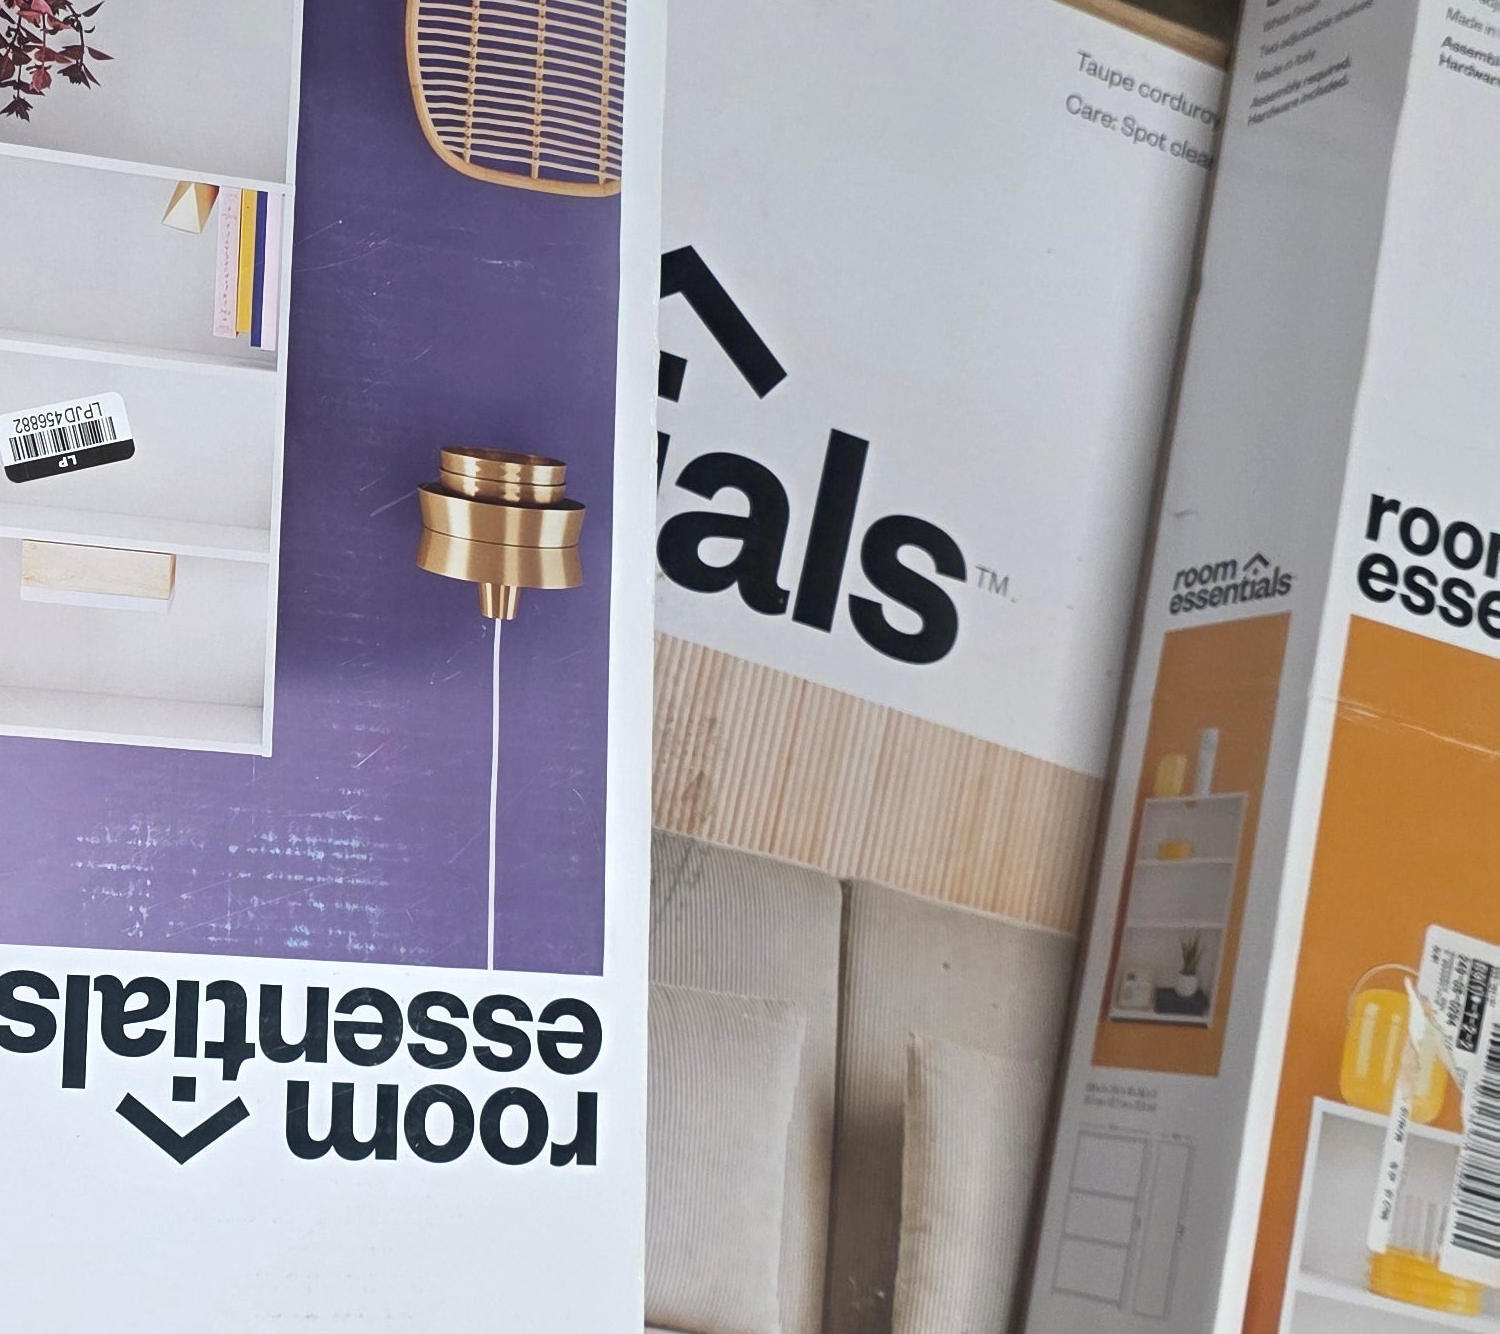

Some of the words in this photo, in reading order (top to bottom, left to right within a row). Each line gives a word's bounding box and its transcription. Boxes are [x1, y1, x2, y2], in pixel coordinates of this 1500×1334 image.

[1077, 49, 1136, 92] Taupe
[1066, 93, 1117, 131] Care:
[1121, 115, 1167, 152] Spot
[12, 402, 103, 434] LPJD456882
[58, 454, 78, 468] LP
[656, 429, 967, 665] als
[1169, 565, 1293, 615] essentials
[1173, 558, 1237, 591] room
[286, 1080, 598, 1168] room
